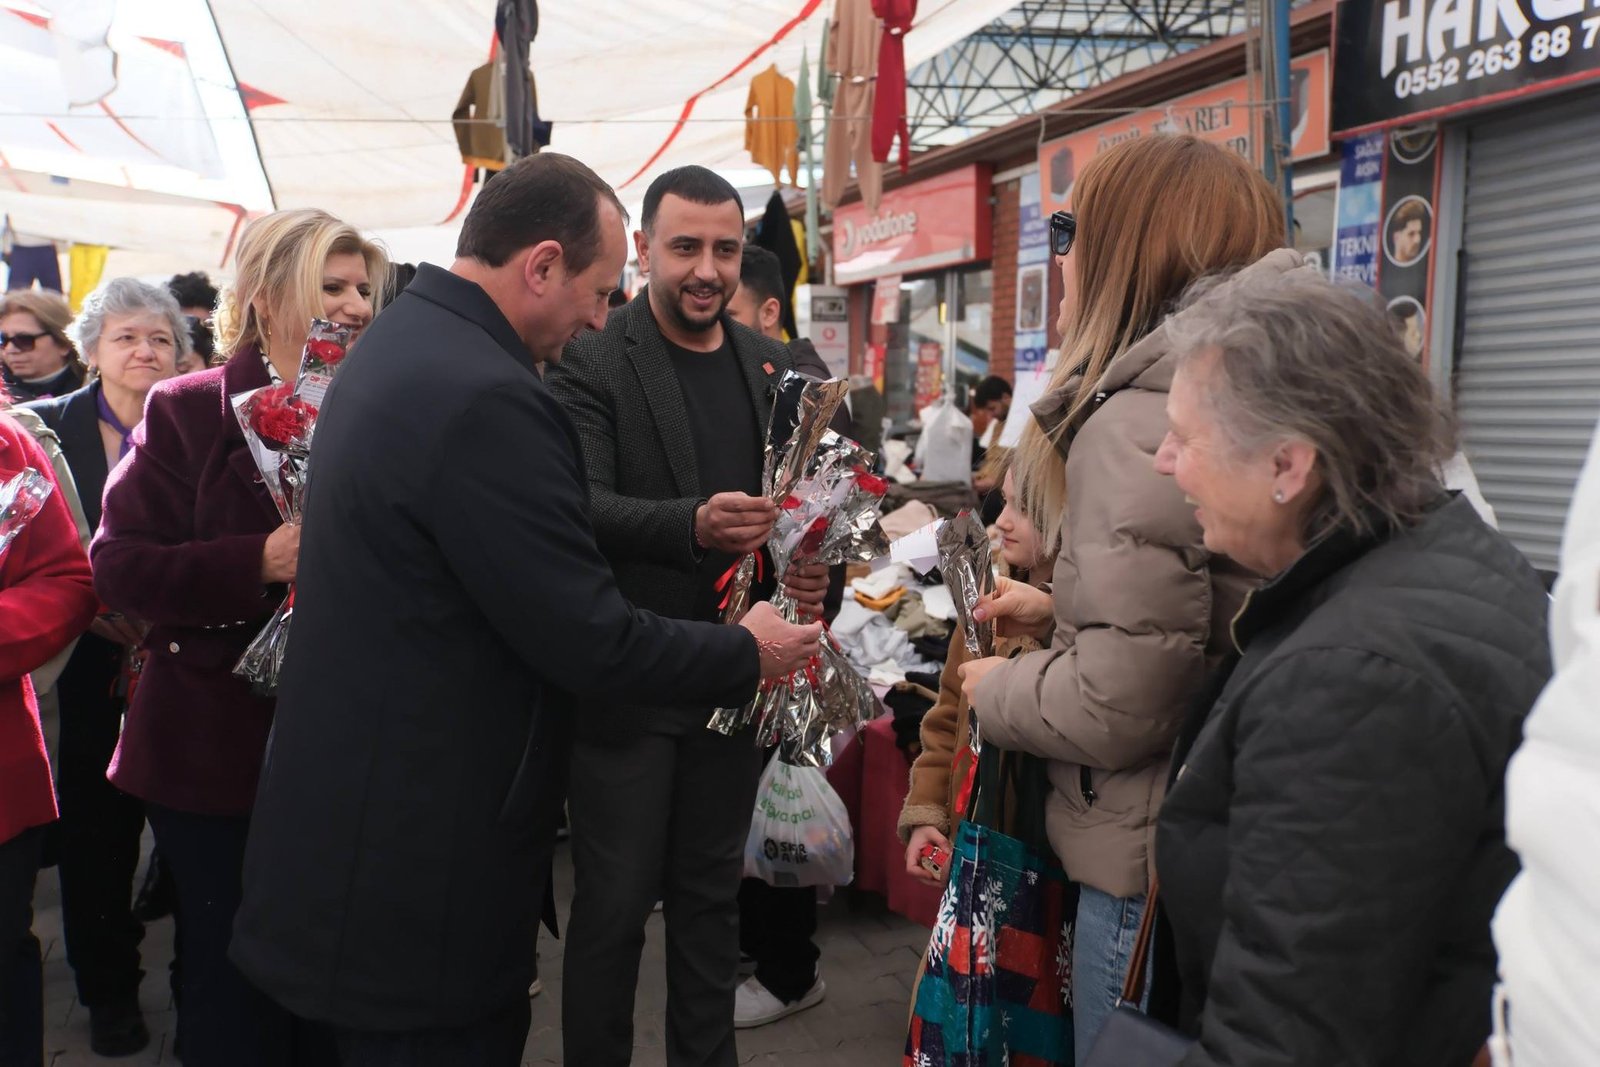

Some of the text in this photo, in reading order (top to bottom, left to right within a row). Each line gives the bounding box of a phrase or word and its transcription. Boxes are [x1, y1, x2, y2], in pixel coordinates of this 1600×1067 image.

[1395, 57, 1460, 99] 0552
[1466, 39, 1522, 80] 263
[1529, 25, 1571, 63] 88
[858, 210, 918, 246] vodafone
